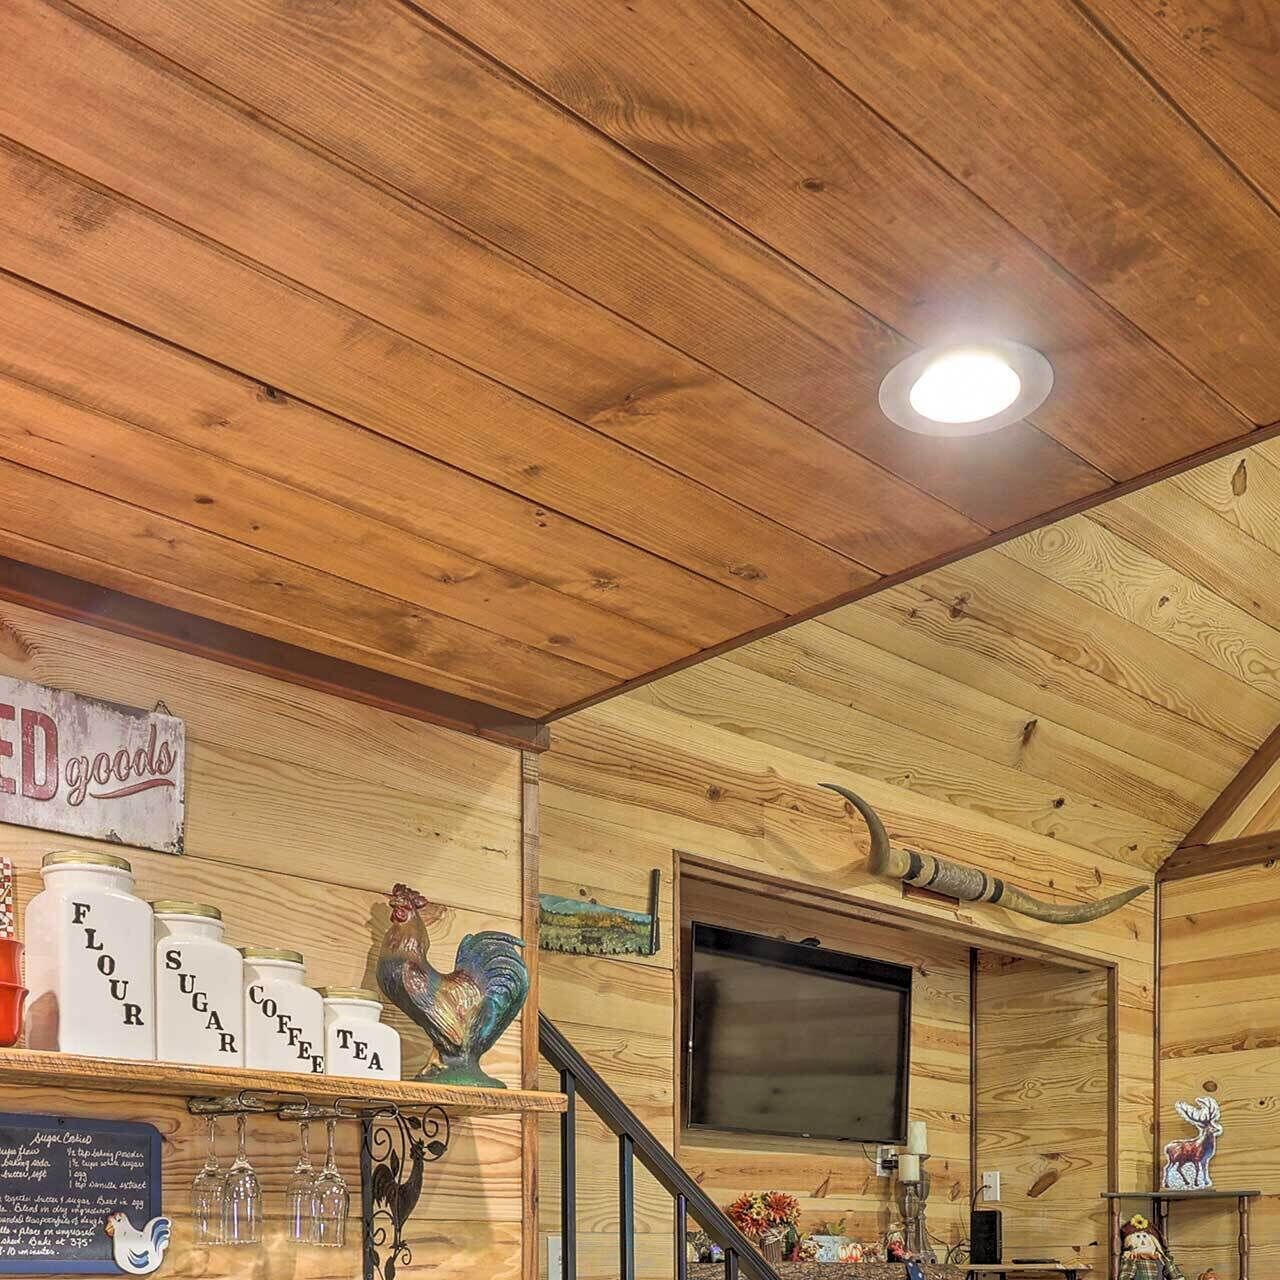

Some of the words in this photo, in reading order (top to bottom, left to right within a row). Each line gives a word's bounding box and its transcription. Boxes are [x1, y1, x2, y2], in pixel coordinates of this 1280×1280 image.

[66, 723, 177, 808] goods
[71, 902, 145, 1026] FLOUR
[165, 949, 239, 1054] SUGAR
[248, 985, 325, 1075] COFFEE
[337, 1029, 384, 1071] TEA
[29, 1132, 62, 1148] Sugar
